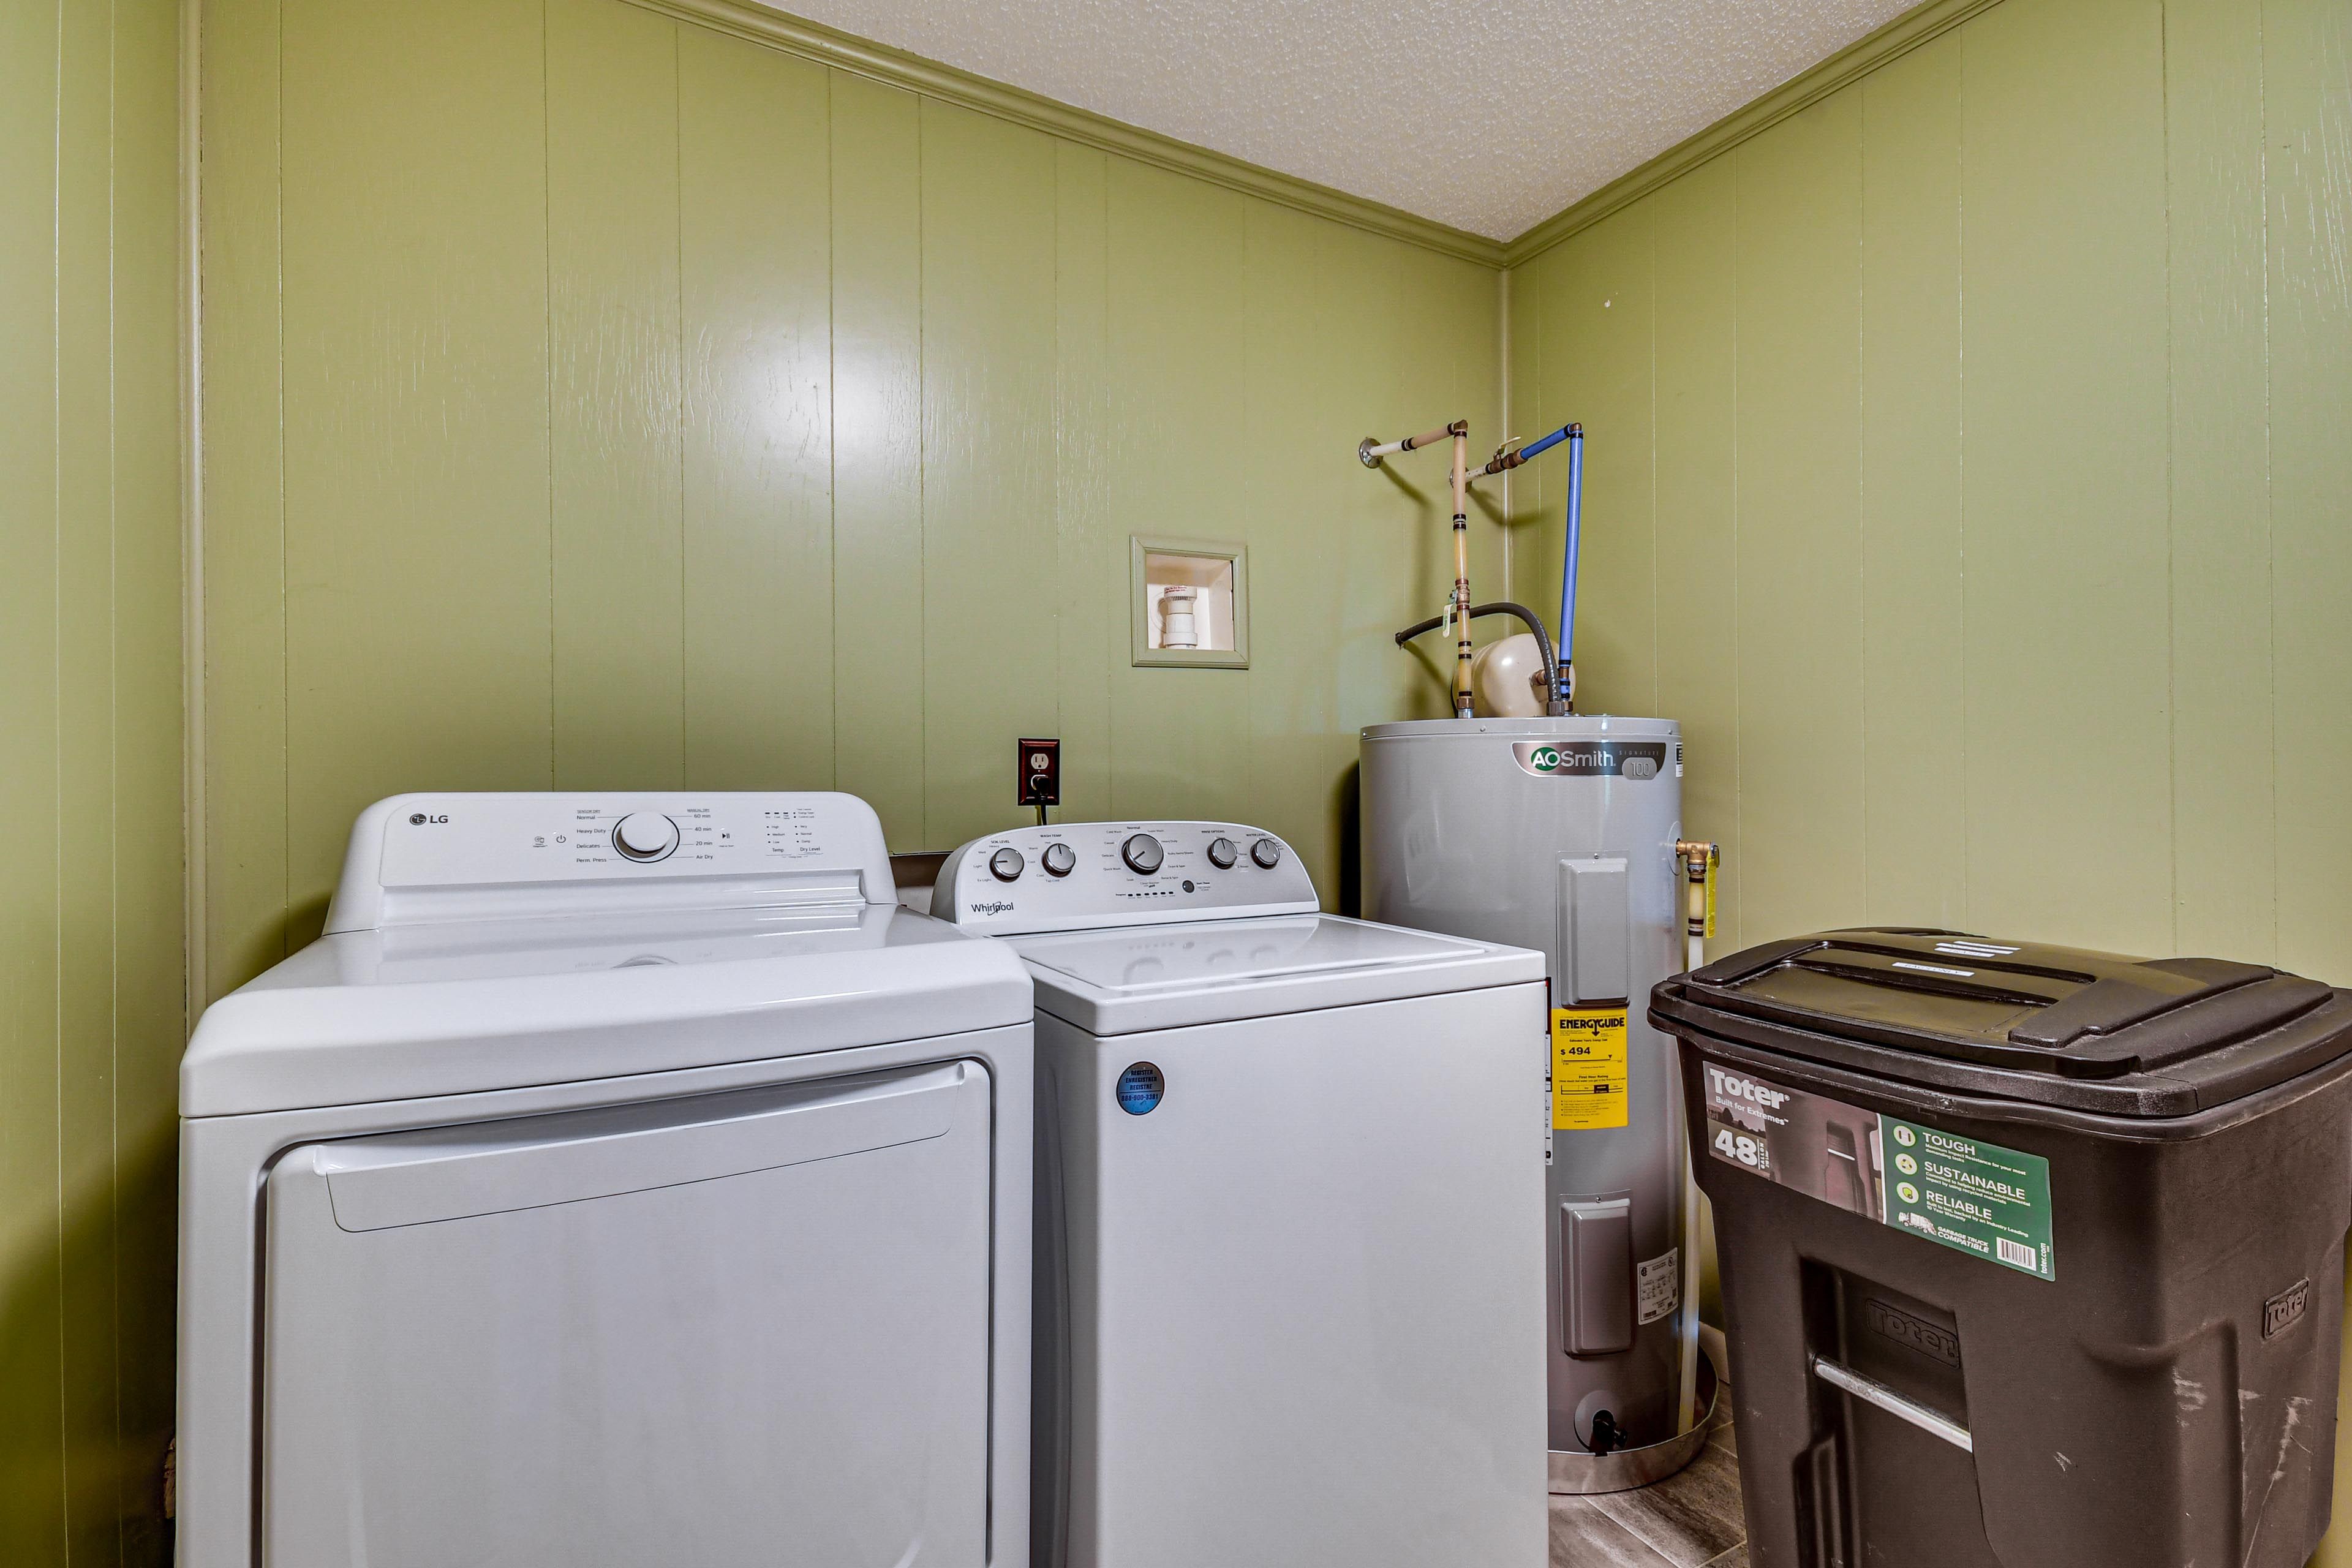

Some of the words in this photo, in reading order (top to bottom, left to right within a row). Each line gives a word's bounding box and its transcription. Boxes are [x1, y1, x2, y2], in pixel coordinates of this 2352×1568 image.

[1631, 761, 1650, 776] 100
[429, 815, 449, 824] LG
[971, 902, 1014, 916] Whirlpool
[1559, 1017, 1625, 1030] ENERGYGUIDE
[1709, 1068, 1785, 1109] Toter
[1716, 1096, 1733, 1108] Built
[1735, 1100, 1746, 1112] for
[1715, 1129, 1758, 1166] 48
[1923, 1132, 1975, 1156] TOUGH
[1925, 1148, 1951, 1160] demanding
[1925, 1143, 1948, 1153] Maximum
[1965, 1155, 1991, 1166] Resistance
[1924, 1161, 2026, 1200] SUSTAINABLE
[1925, 1172, 1951, 1183] Committed
[1957, 1180, 1975, 1191] helping
[1976, 1187, 1993, 1196] reduce
[1994, 1193, 2031, 1207] environmental
[1926, 1190, 1992, 1220] RELIABLE
[1949, 1183, 1962, 1192] using
[1962, 1188, 1983, 1198] recycled
[1983, 1194, 2007, 1205] materials
[1945, 1212, 1966, 1222] Warranty
[1954, 1209, 1971, 1219] backed
[1986, 1219, 2007, 1231] Industry
[2007, 1226, 2029, 1238] Leading
[1937, 1231, 1989, 1254] COMPATIBLE
[1938, 1226, 1966, 1239] GARBAGE
[1967, 1235, 1988, 1247] TRUCK
[2268, 1286, 2308, 1335] Toter
